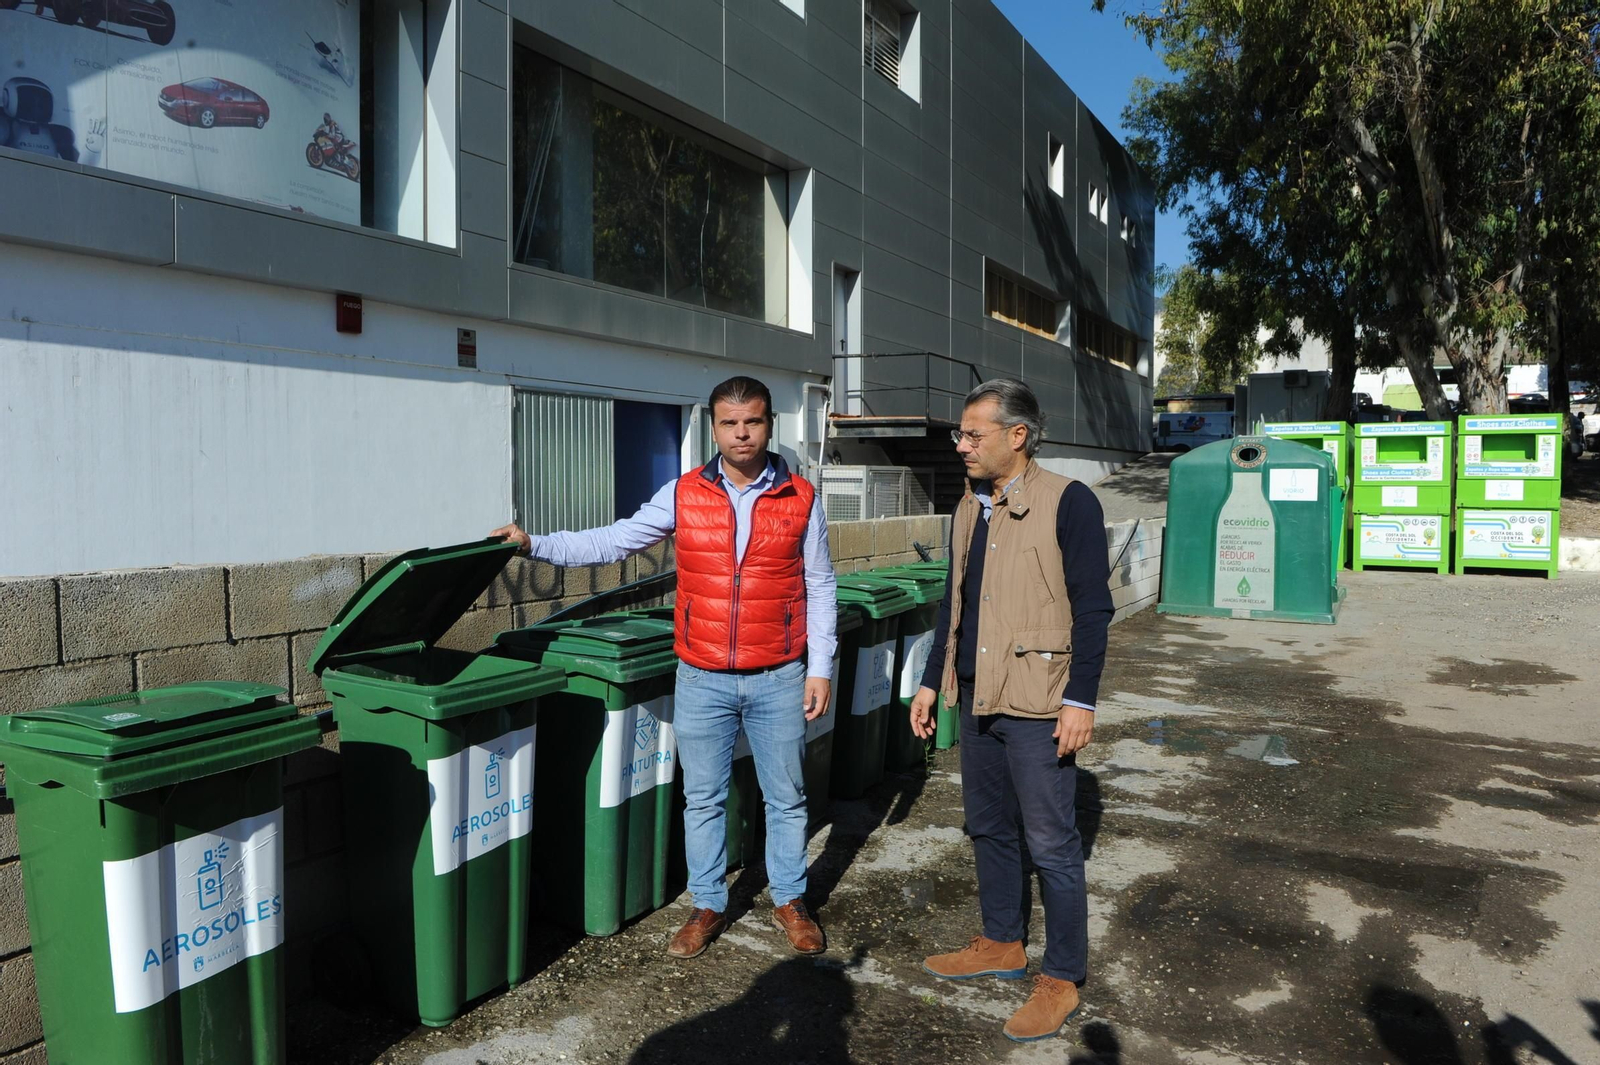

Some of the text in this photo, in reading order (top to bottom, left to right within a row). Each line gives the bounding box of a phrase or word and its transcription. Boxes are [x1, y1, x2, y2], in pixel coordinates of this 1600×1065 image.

[74, 58, 91, 68] FCX
[120, 68, 156, 82] emisiones
[112, 136, 187, 156] avanzado del mundo.
[113, 126, 220, 154] Asimo, el robot humanoide más
[344, 301, 362, 310] FUEGO
[1223, 517, 1270, 528] ecovidrio
[1220, 550, 1255, 560] REDUCIR
[142, 894, 282, 973] AEROSOLES
[207, 944, 240, 963] MARBELLA
